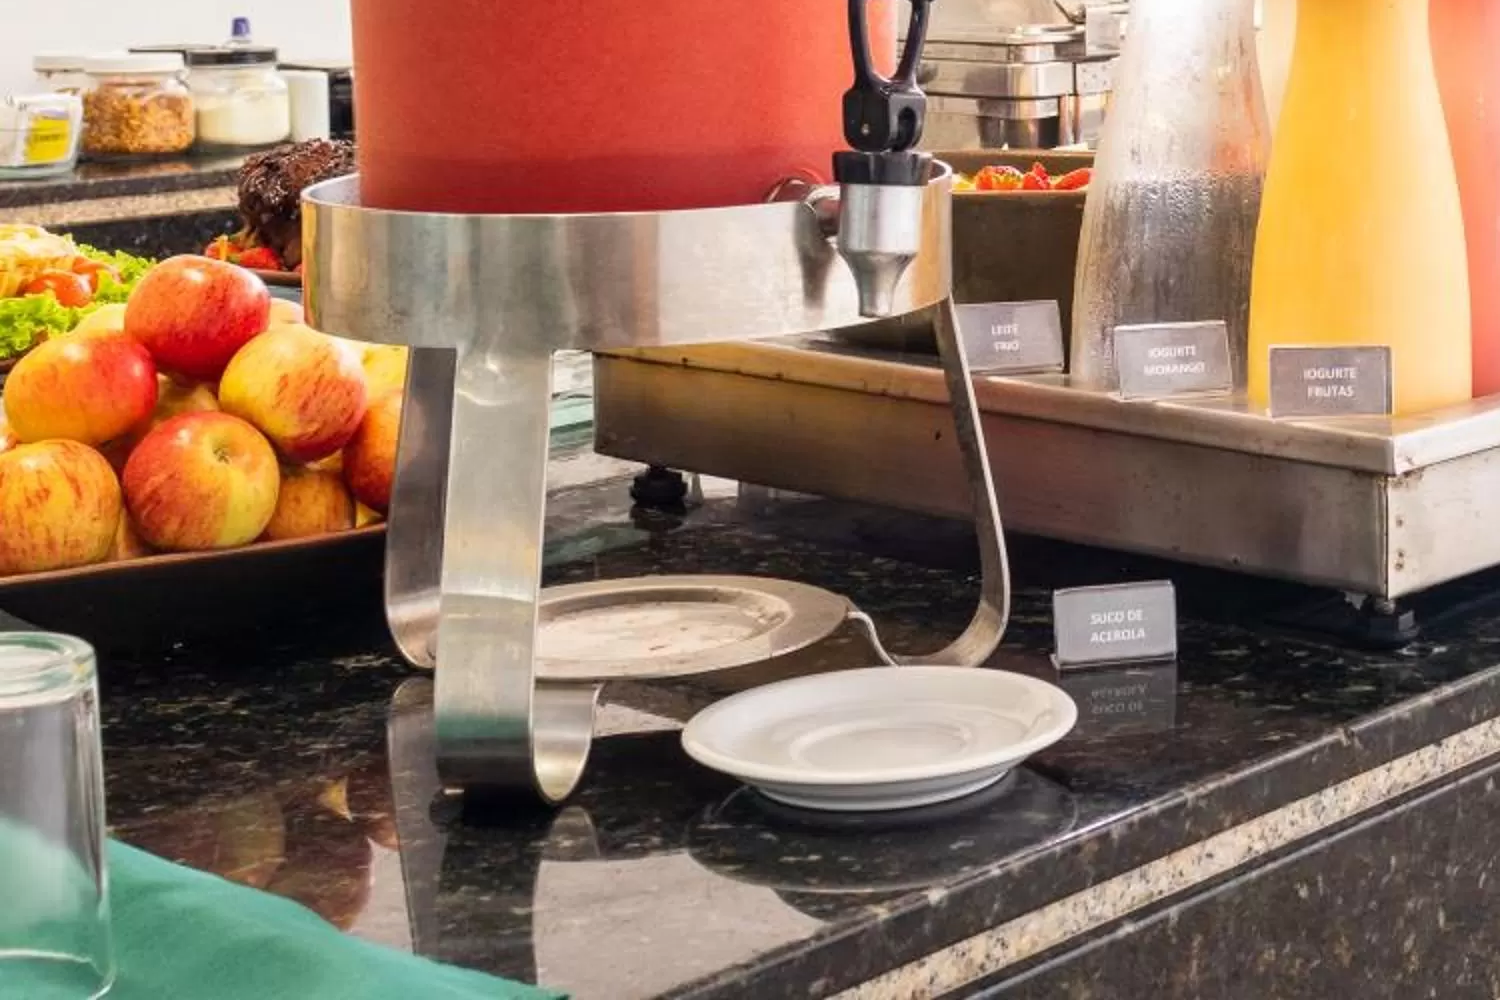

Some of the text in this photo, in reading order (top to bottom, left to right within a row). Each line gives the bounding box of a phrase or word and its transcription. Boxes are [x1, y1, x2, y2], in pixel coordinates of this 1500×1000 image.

[1303, 367, 1357, 380] IOGURTE
[1307, 385, 1354, 398] FRUTAS
[1090, 609, 1144, 625] SUCO DE
[1090, 627, 1145, 642] ACEROLA
